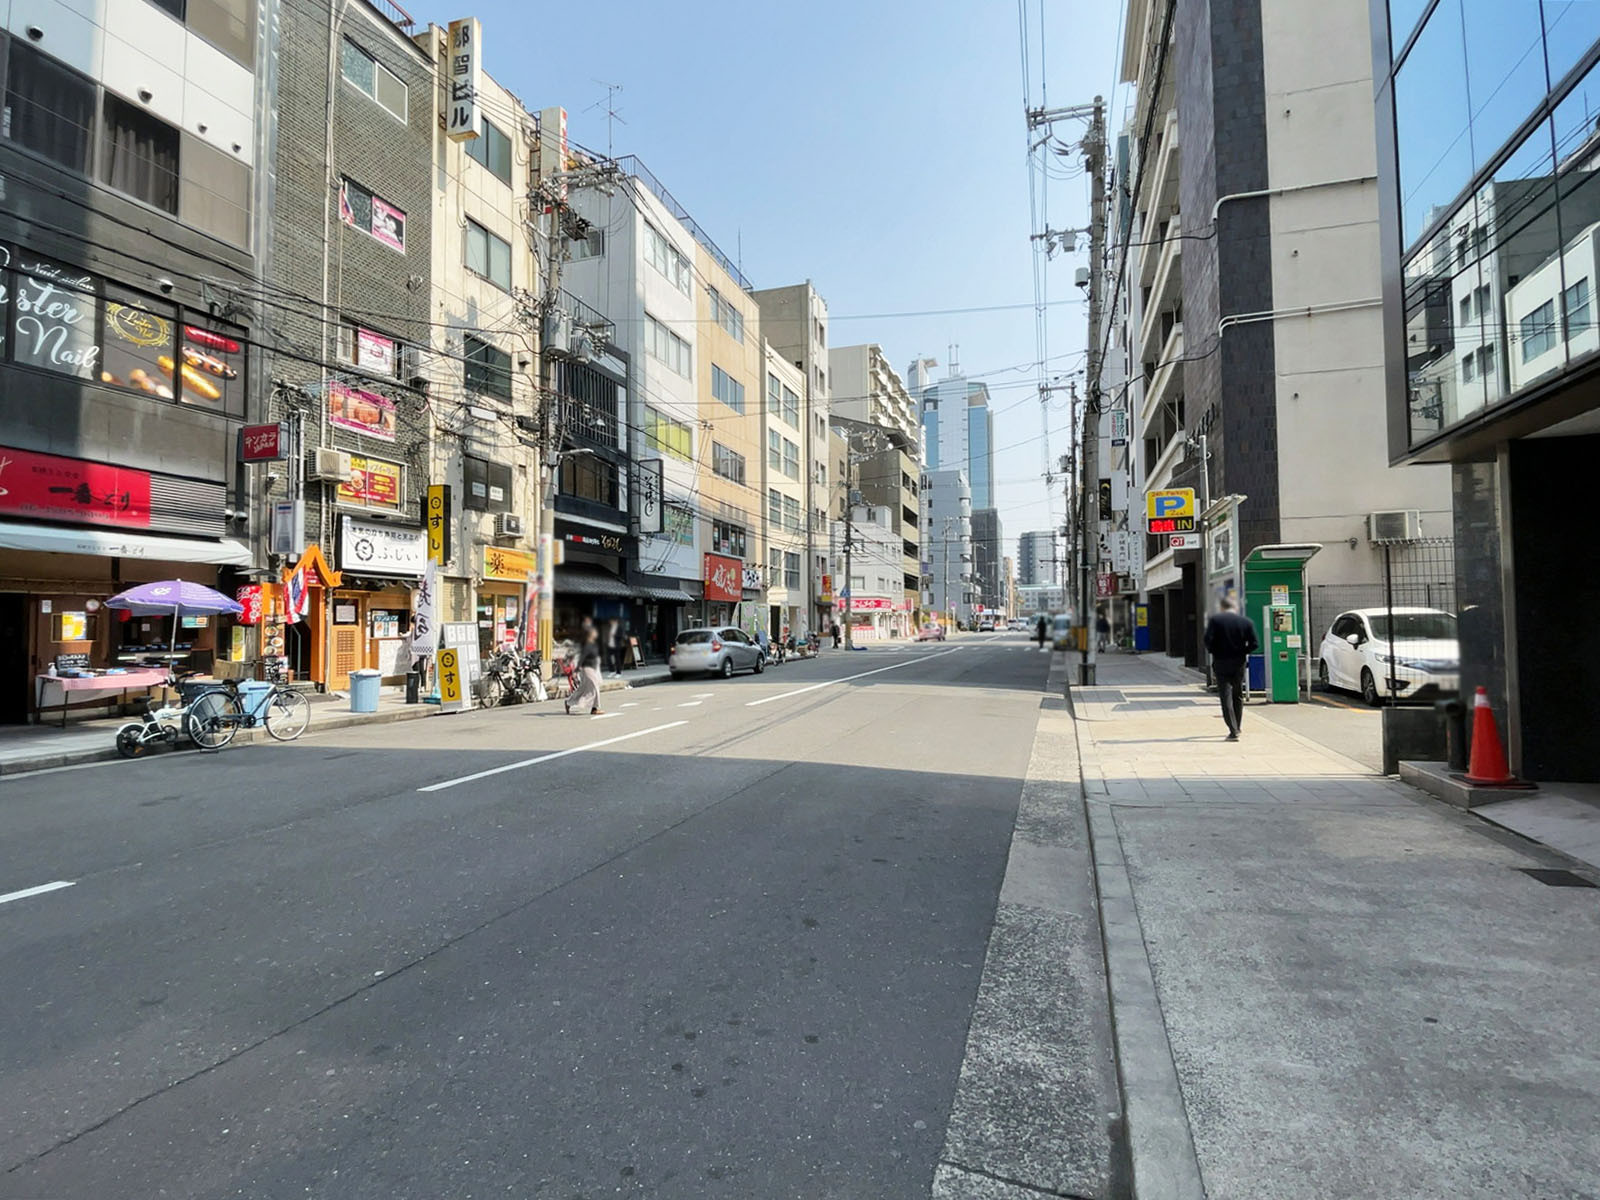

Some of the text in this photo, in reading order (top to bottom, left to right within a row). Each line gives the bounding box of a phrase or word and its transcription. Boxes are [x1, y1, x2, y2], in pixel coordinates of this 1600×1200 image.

[16, 316, 99, 368] Nail
[1156, 496, 1186, 516] P
[430, 513, 442, 551] すし
[1177, 520, 1193, 530] IN
[378, 547, 419, 561] ふじい
[444, 671, 457, 698] すし
